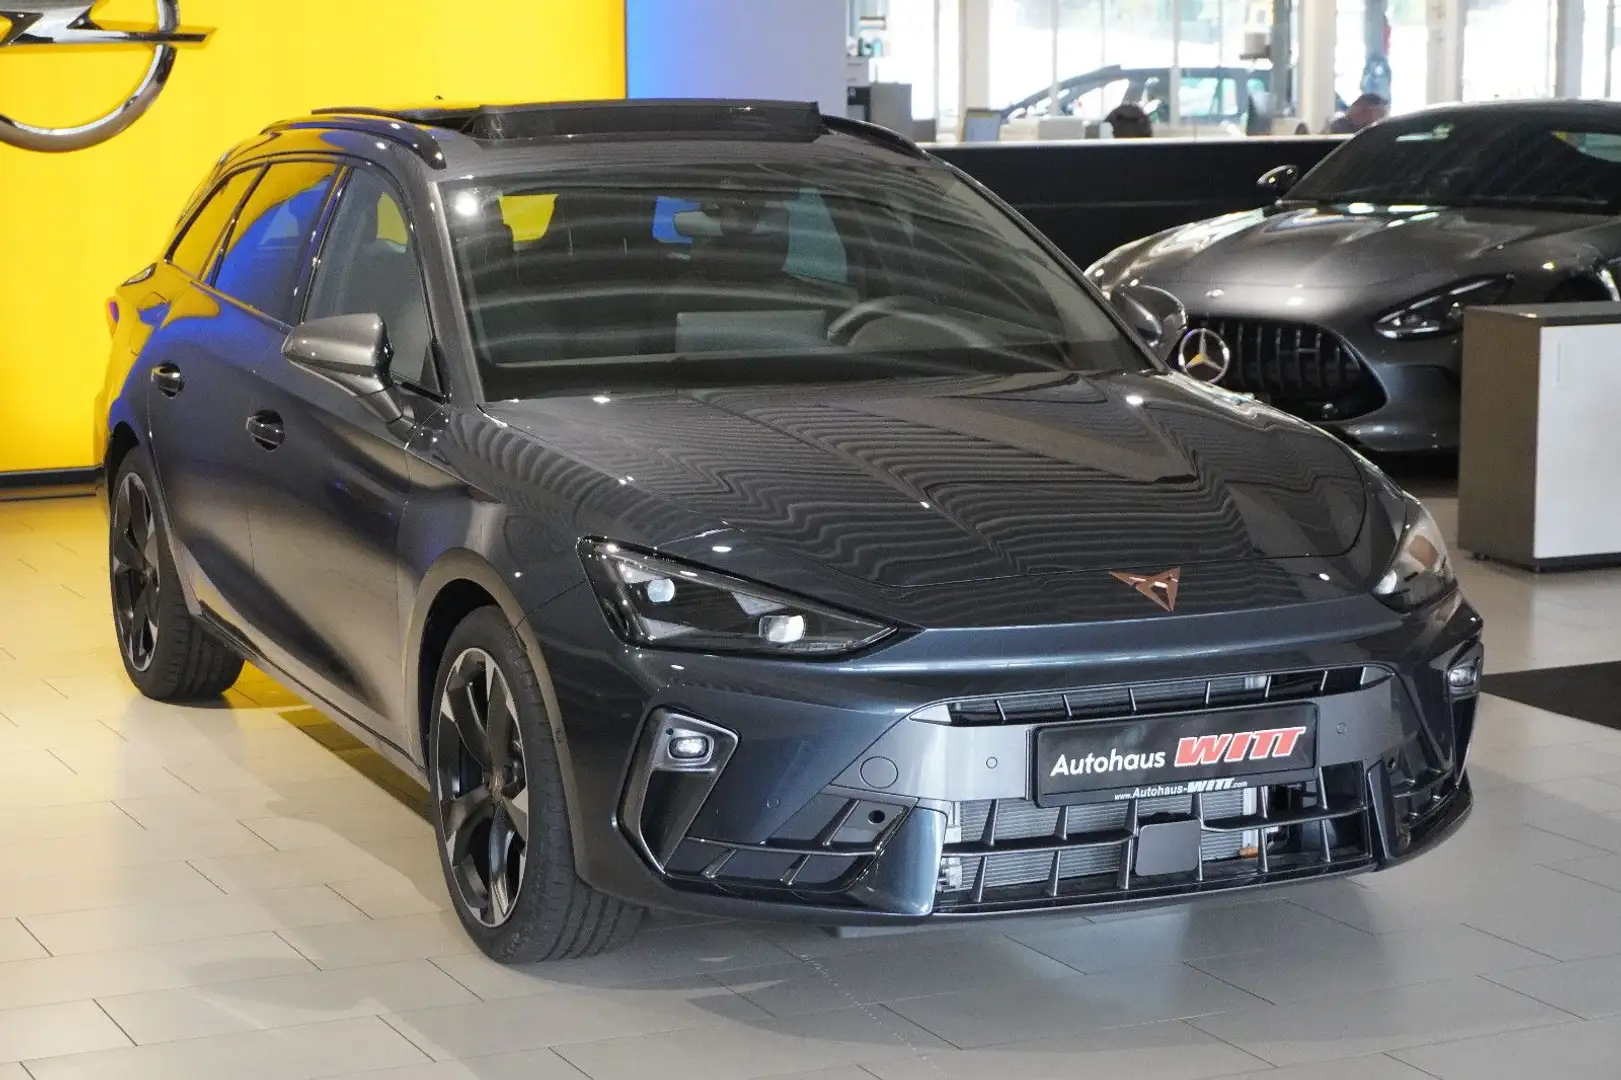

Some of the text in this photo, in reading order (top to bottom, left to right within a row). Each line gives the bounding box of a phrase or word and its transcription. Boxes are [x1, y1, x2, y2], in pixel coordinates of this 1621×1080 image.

[1050, 726, 1307, 777] Autohaus WITT
[1114, 778, 1248, 800] www.Autohaus-WITT.com
